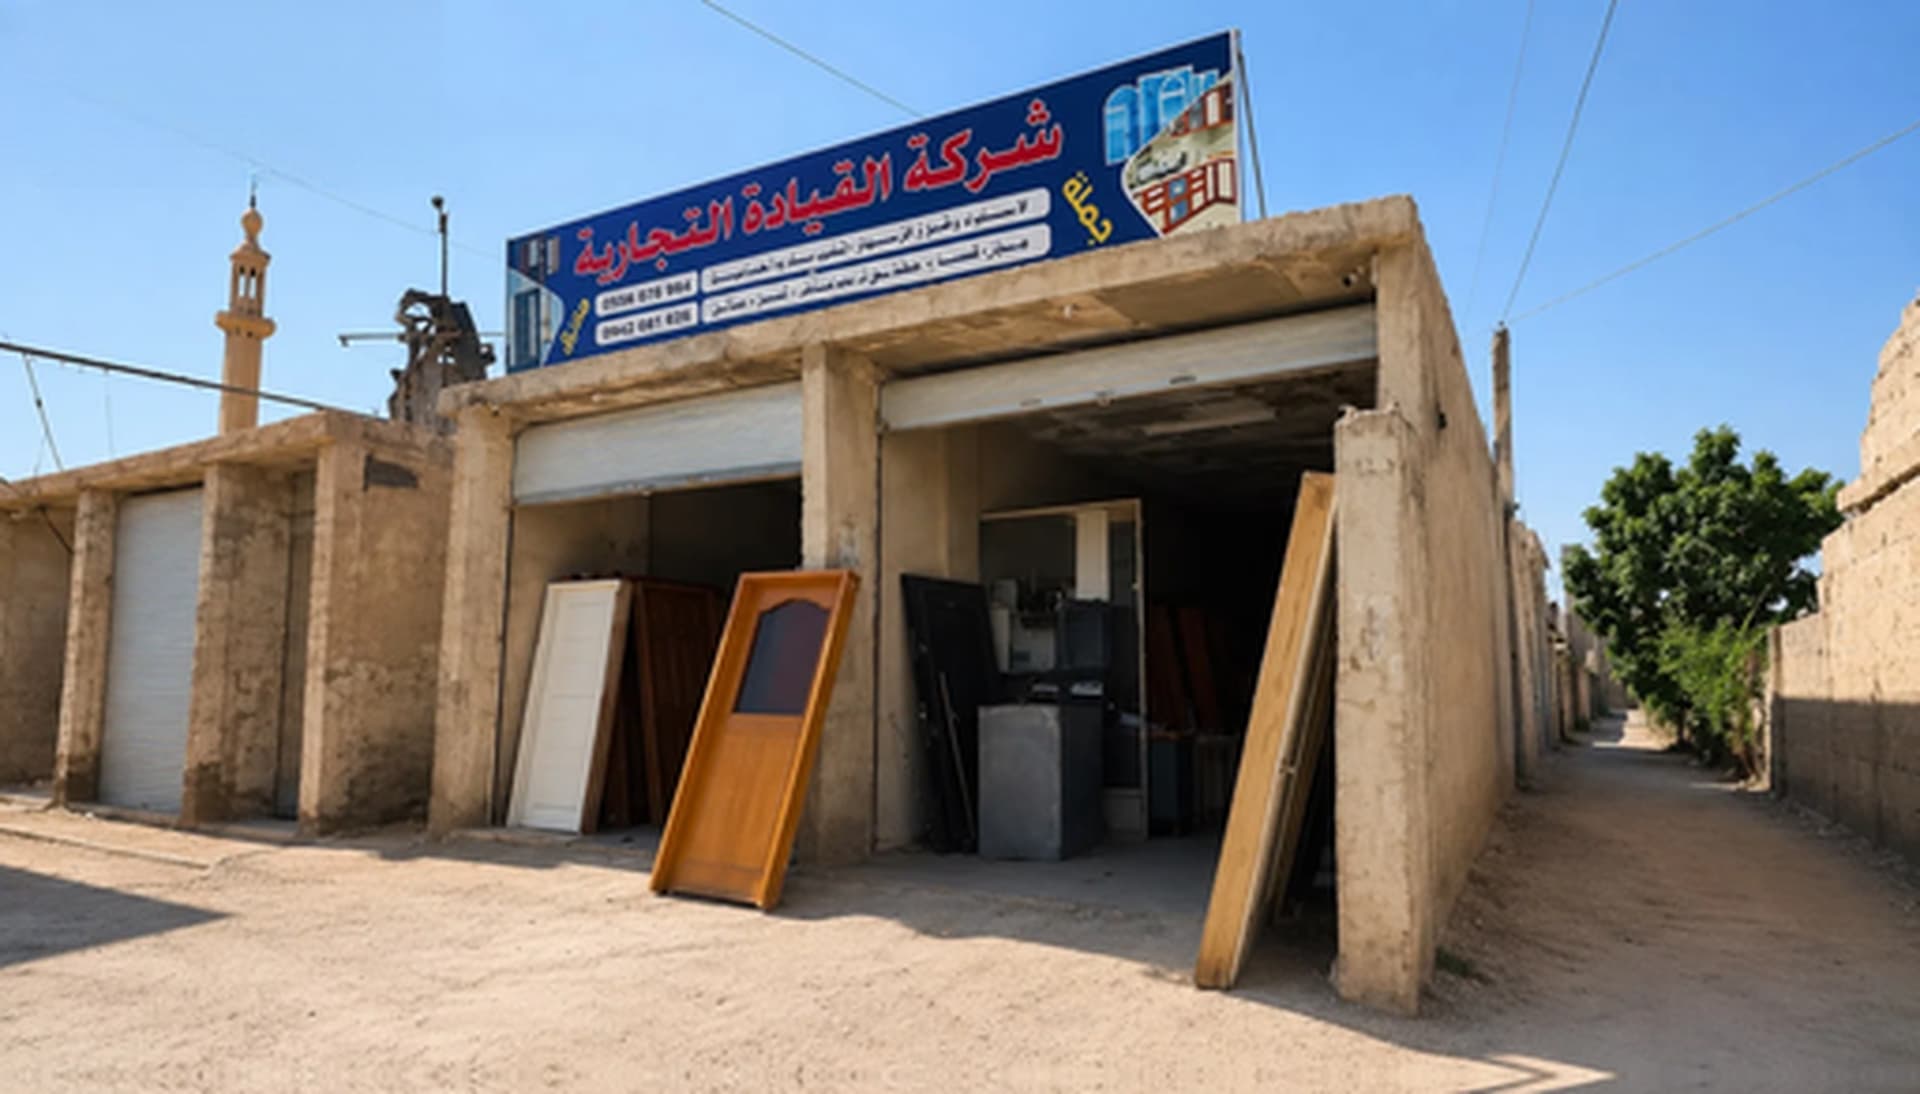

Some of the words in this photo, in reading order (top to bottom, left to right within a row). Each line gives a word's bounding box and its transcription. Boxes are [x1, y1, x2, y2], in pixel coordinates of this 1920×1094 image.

[904, 99, 1063, 192] شركة
[742, 152, 893, 234] القيادة
[1062, 170, 1113, 246] جملة
[574, 196, 734, 285] التجارية
